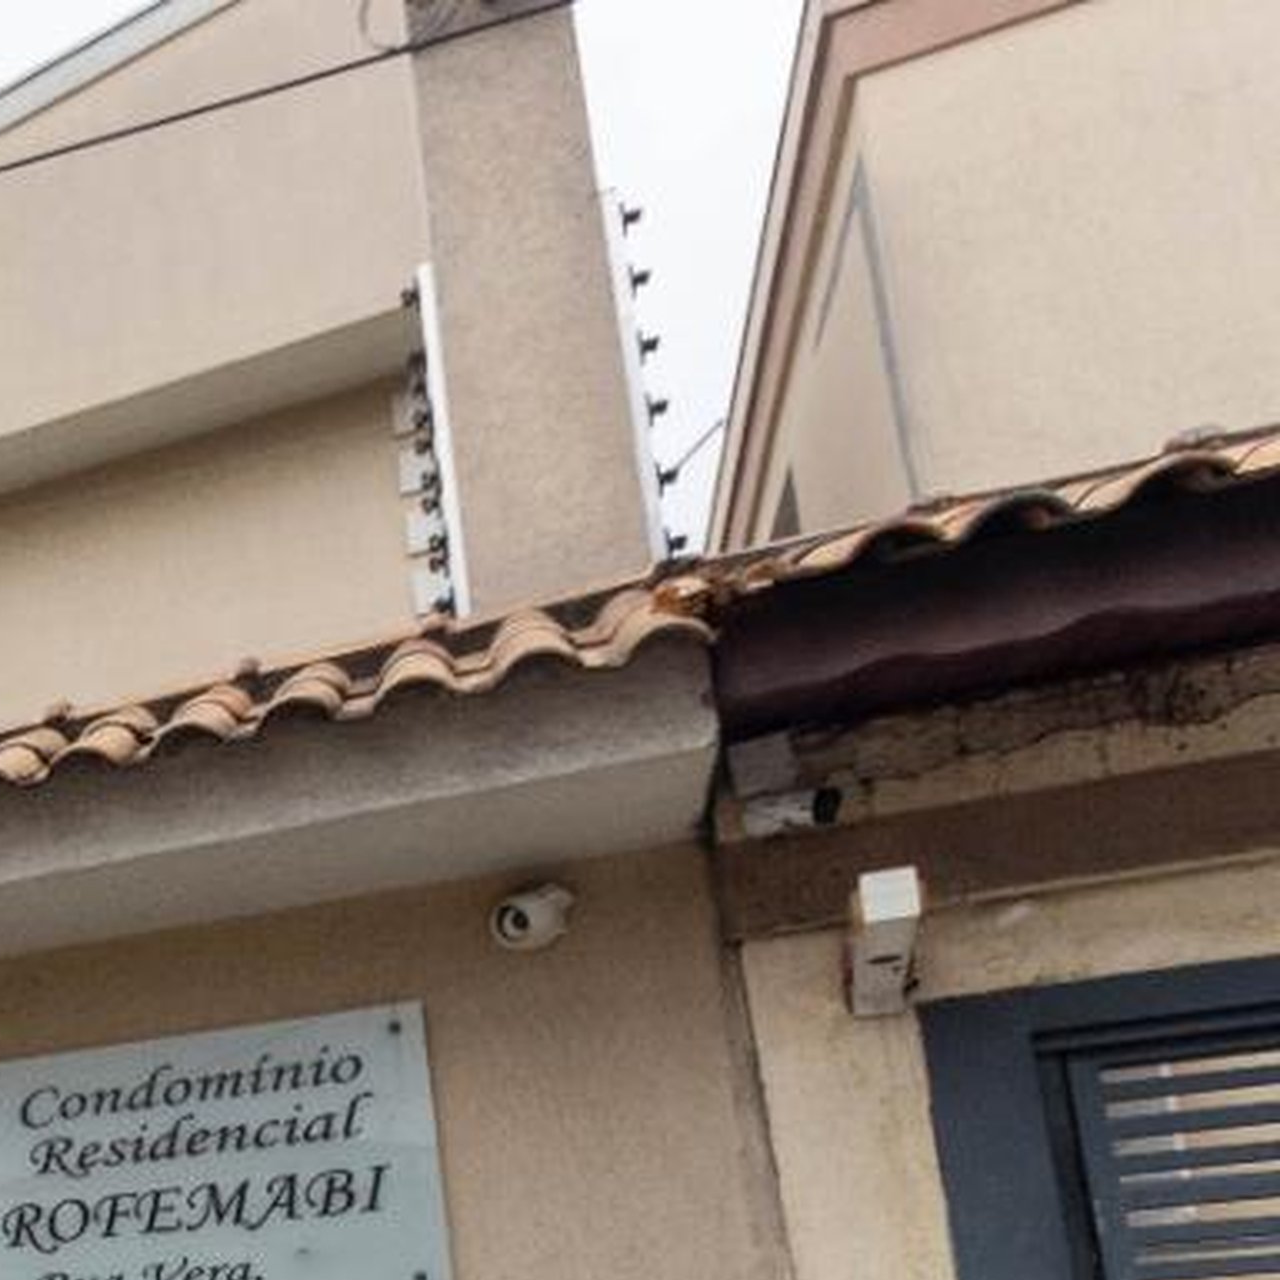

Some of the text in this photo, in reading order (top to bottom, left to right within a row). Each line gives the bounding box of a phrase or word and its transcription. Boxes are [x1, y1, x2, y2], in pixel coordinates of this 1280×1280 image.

[19, 1045, 363, 1129] Condomínio
[29, 1091, 373, 1179] Residencial
[1, 1163, 392, 1254] ROFEMABI
